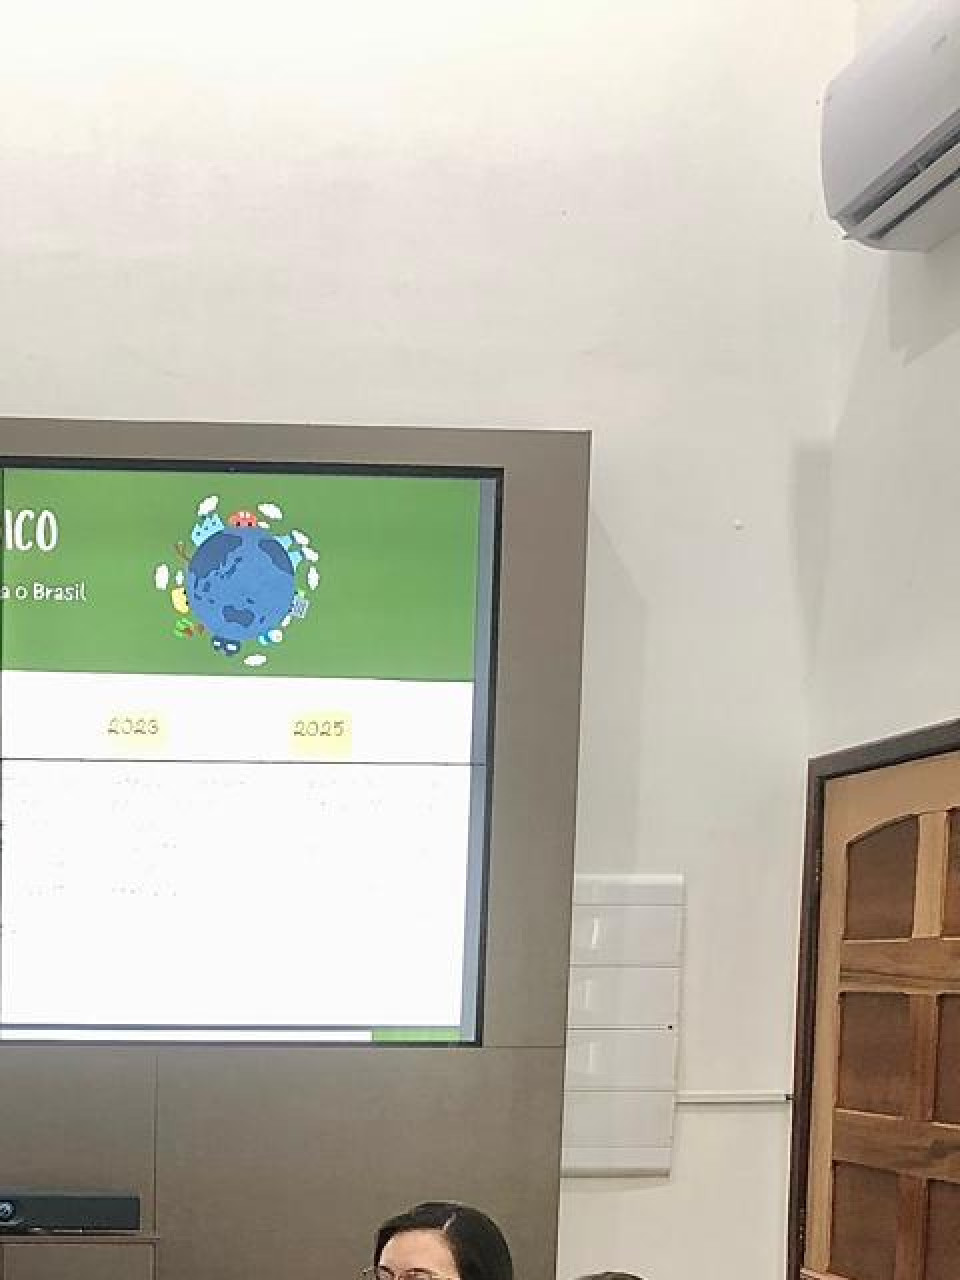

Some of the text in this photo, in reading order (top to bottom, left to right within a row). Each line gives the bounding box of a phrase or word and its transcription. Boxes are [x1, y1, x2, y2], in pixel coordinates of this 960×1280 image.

[15, 585, 28, 599] o
[33, 582, 87, 600] Brasil
[293, 719, 345, 737] 2025
